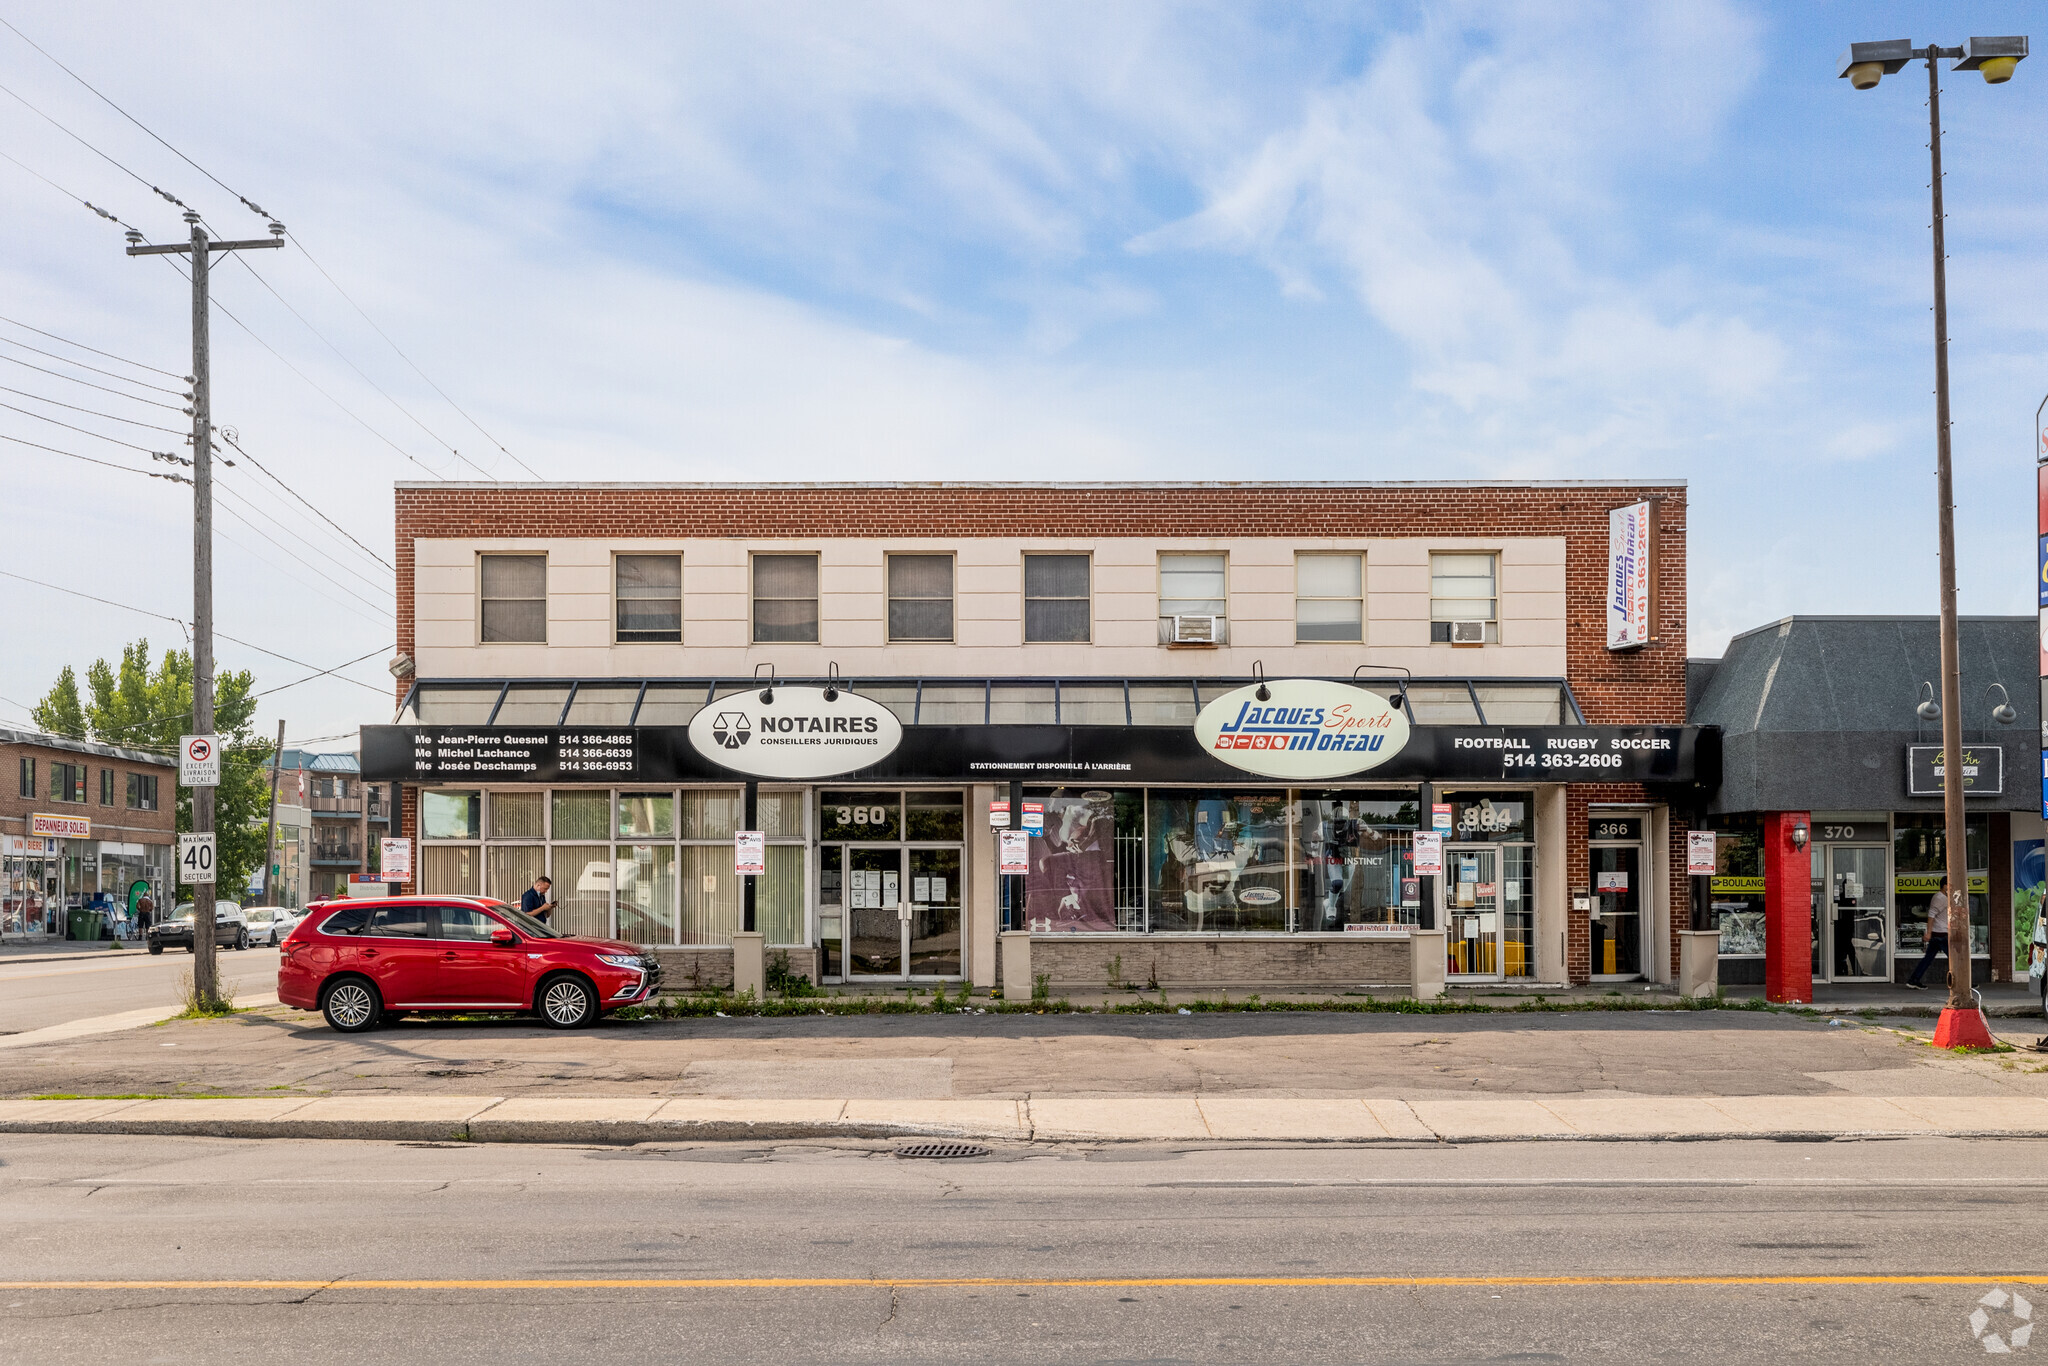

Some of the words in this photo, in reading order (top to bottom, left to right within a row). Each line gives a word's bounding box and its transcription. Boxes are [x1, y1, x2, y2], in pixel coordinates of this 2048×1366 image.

[1638, 505, 1647, 588] 363-2606
[1613, 555, 1627, 622] JACQUES
[1637, 595, 1647, 641] (514)
[1220, 701, 1325, 732] JACQUES
[1324, 704, 1392, 734] Sports
[760, 717, 878, 733] NOTAIRES
[415, 735, 432, 744] Me
[438, 735, 501, 744] Jean-Pierre
[503, 735, 548, 745] Quesnel
[559, 736, 580, 744] 514
[582, 736, 632, 744] 366-4865
[824, 738, 878, 746] JURIDIQUES
[1289, 728, 1385, 751] MOREAU
[1454, 738, 1530, 749] FOOTBALL
[1547, 739, 1599, 749] RUGBY
[1611, 739, 1671, 749] SOCCER
[415, 749, 432, 758] Me
[438, 748, 474, 758] Michel
[477, 748, 530, 758] Lachance
[559, 749, 580, 758] 514
[582, 749, 633, 758] 366-6639
[415, 761, 432, 770] Me
[438, 761, 470, 771] Josée
[473, 761, 537, 773] Deschamps
[559, 761, 580, 770] 514
[582, 761, 633, 770] 366-6953
[970, 762, 1035, 770] STATIONNEMENT
[1036, 762, 1083, 770] DISPONIBLE
[1084, 761, 1090, 770] À
[1091, 762, 1132, 770] L'ARRIÈRE
[1504, 754, 1536, 767] 514
[1541, 754, 1622, 767] 363-2606
[836, 806, 885, 825] 360
[1464, 808, 1513, 827] 364
[34, 817, 68, 833] DÉPANNEUR
[69, 821, 88, 834] SOLEIL
[1600, 823, 1628, 835] 366
[1824, 826, 1855, 839] 370
[13, 839, 24, 849] VIN
[184, 845, 212, 870] 40
[1344, 857, 1383, 865] INSTINCT
[1477, 885, 1496, 895] Ouvert
